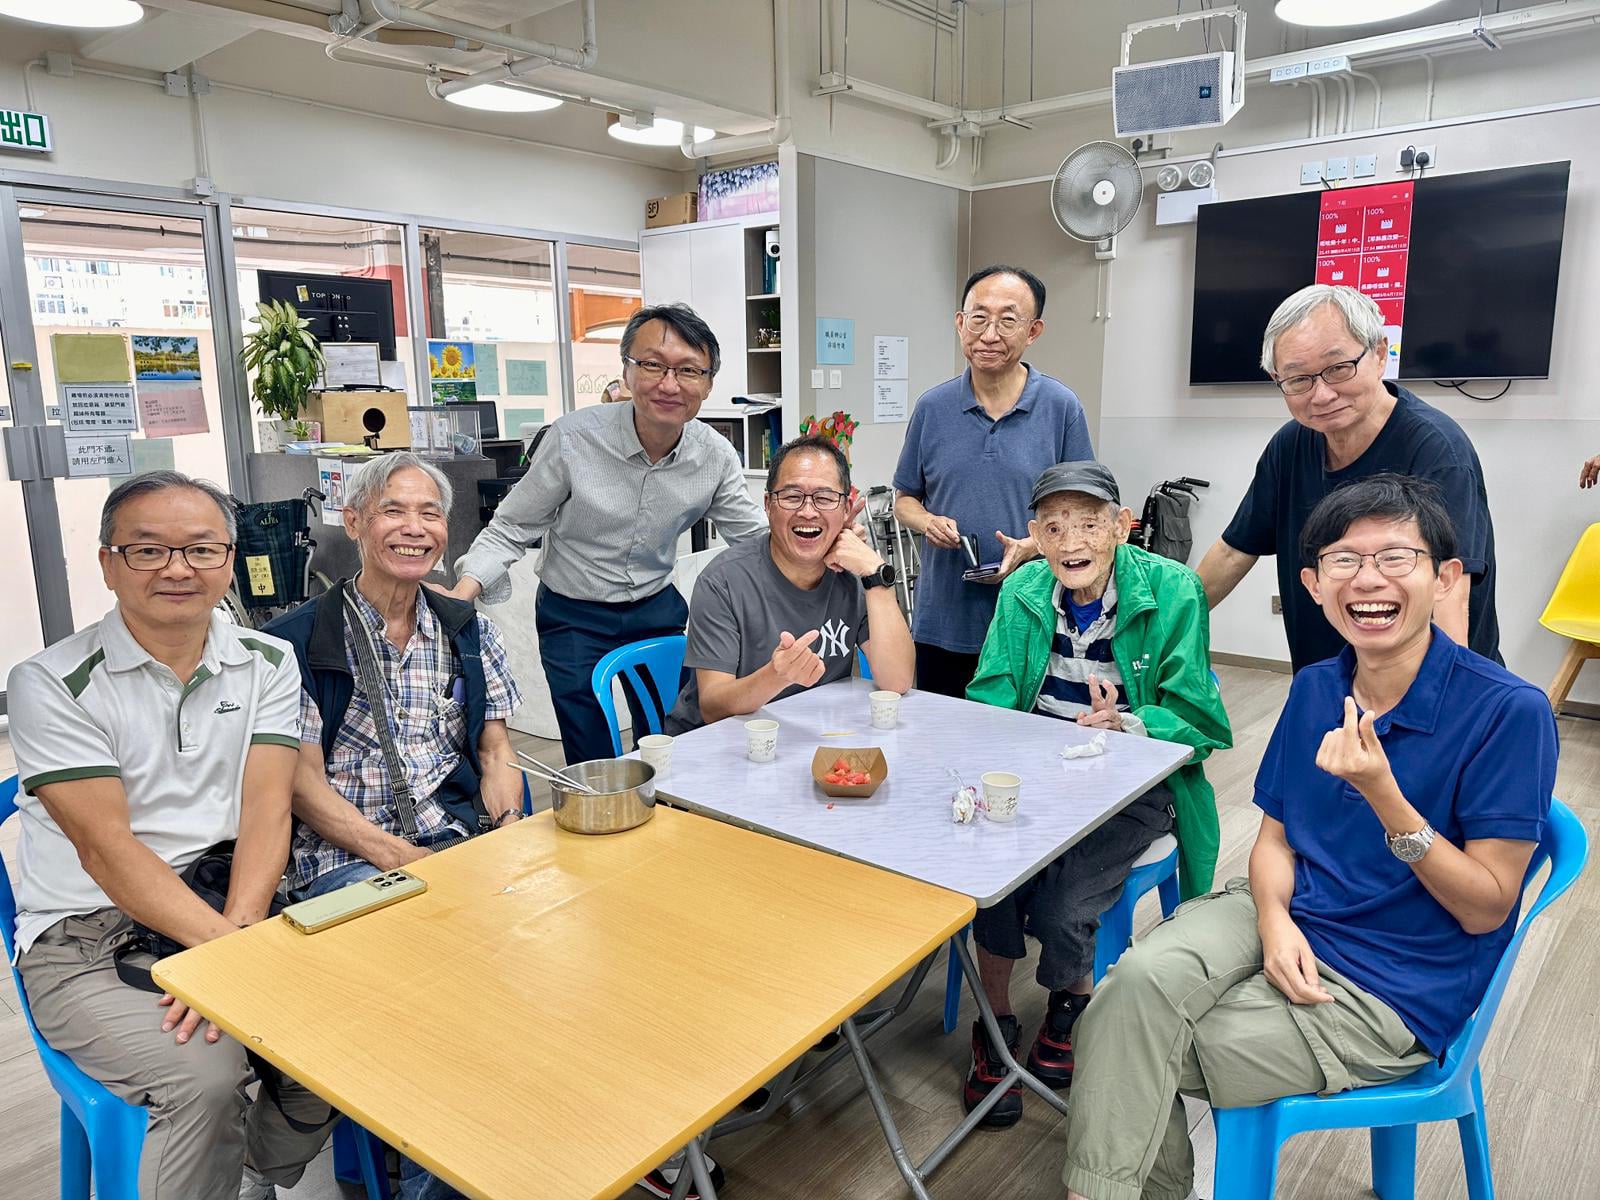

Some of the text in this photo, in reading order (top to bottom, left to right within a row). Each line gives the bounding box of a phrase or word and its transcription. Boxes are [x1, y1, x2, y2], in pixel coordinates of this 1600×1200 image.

[0, 110, 47, 148] 出口
[1366, 207, 1385, 215] 100%
[1321, 212, 1339, 220] 100%
[1318, 259, 1336, 267] 100%
[1362, 255, 1381, 264] 100%
[51, 407, 61, 416] 拉
[258, 583, 266, 594] 中
[816, 618, 850, 659] NY
